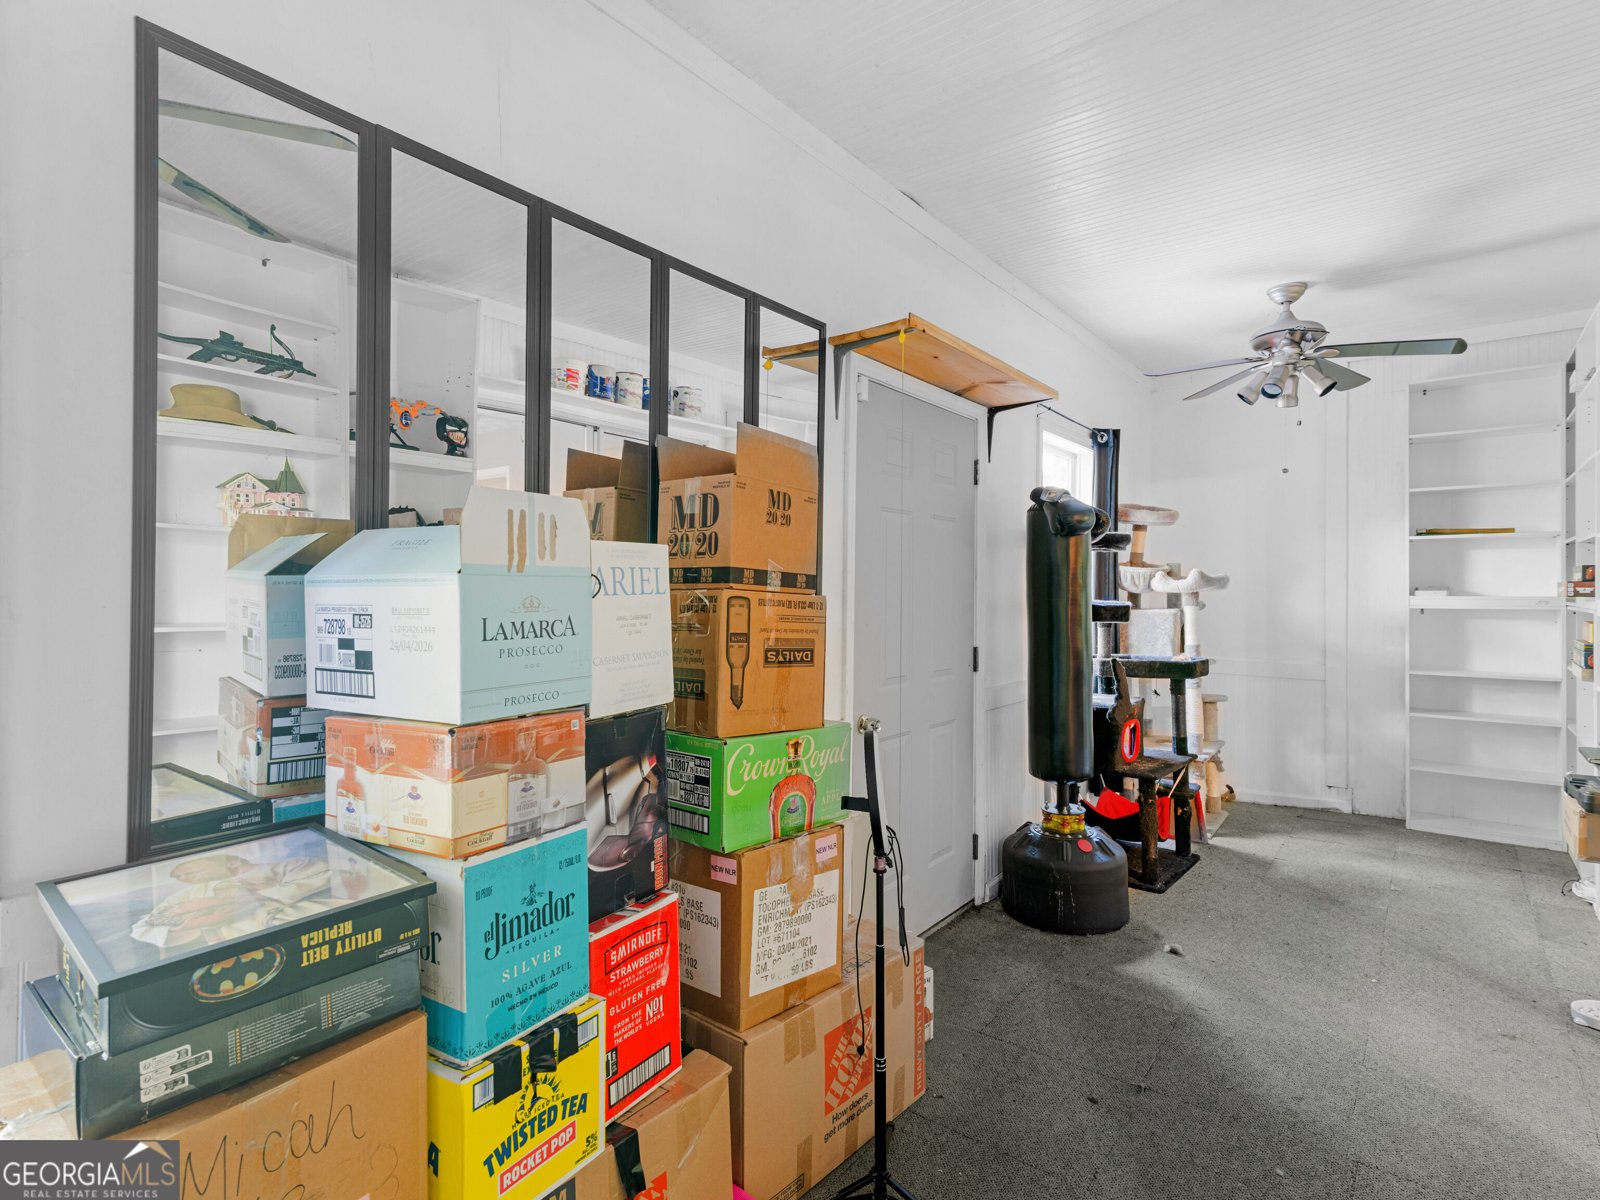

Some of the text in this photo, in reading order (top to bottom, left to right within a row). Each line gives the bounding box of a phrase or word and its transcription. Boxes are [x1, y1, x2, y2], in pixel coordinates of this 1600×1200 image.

[768, 488, 791, 512] MD
[669, 492, 720, 533] MD
[668, 531, 719, 560] 20/20
[592, 566, 667, 596] ARIEL
[673, 568, 713, 577] MD MD
[744, 569, 755, 577] MD
[323, 618, 346, 635] 728798
[498, 644, 564, 659] PROSECCO
[593, 654, 631, 668] CABERNET
[504, 690, 560, 707] PROSECCO
[674, 681, 701, 694] DAIL
[726, 744, 793, 797] Crown
[799, 734, 849, 783] Royal
[816, 843, 837, 854] NEW NLR
[711, 865, 737, 876] NEW NLR
[687, 898, 704, 912] BASE
[300, 920, 353, 949] REPLICA
[335, 927, 382, 956] UTILITY
[757, 936, 770, 949] LOT
[300, 944, 330, 967] BELT
[610, 928, 662, 966] SMIRNOFF
[777, 936, 812, 956] 03/04/2021
[502, 945, 563, 984] SILVER
[610, 945, 664, 983] STRAWBERRY
[647, 962, 667, 976] FLAVOR
[491, 961, 573, 1009] 100% AGAVE AZUL
[508, 996, 529, 1012] HECHO
[529, 993, 537, 1001] EN
[610, 990, 643, 1016] GLUTEN
[614, 1018, 630, 1031] FROM
[631, 1009, 642, 1019] THE
[614, 1017, 642, 1039] MAKERS OF
[646, 1012, 665, 1027] VODKA
[614, 1036, 624, 1046] THE
[830, 1031, 850, 1069] THE
[534, 1100, 551, 1114] ICED
[552, 1093, 565, 1102] TEA
[832, 1092, 869, 1124] How doers
[483, 1104, 559, 1178] TWISTED
[562, 1093, 588, 1121] TEA
[824, 1125, 837, 1144] get
[837, 1112, 856, 1132] more
[181, 1080, 366, 1200] Micah
[586, 1131, 598, 1148] 5%
[501, 1144, 549, 1190] ROCKET
[551, 1126, 574, 1153] POP
